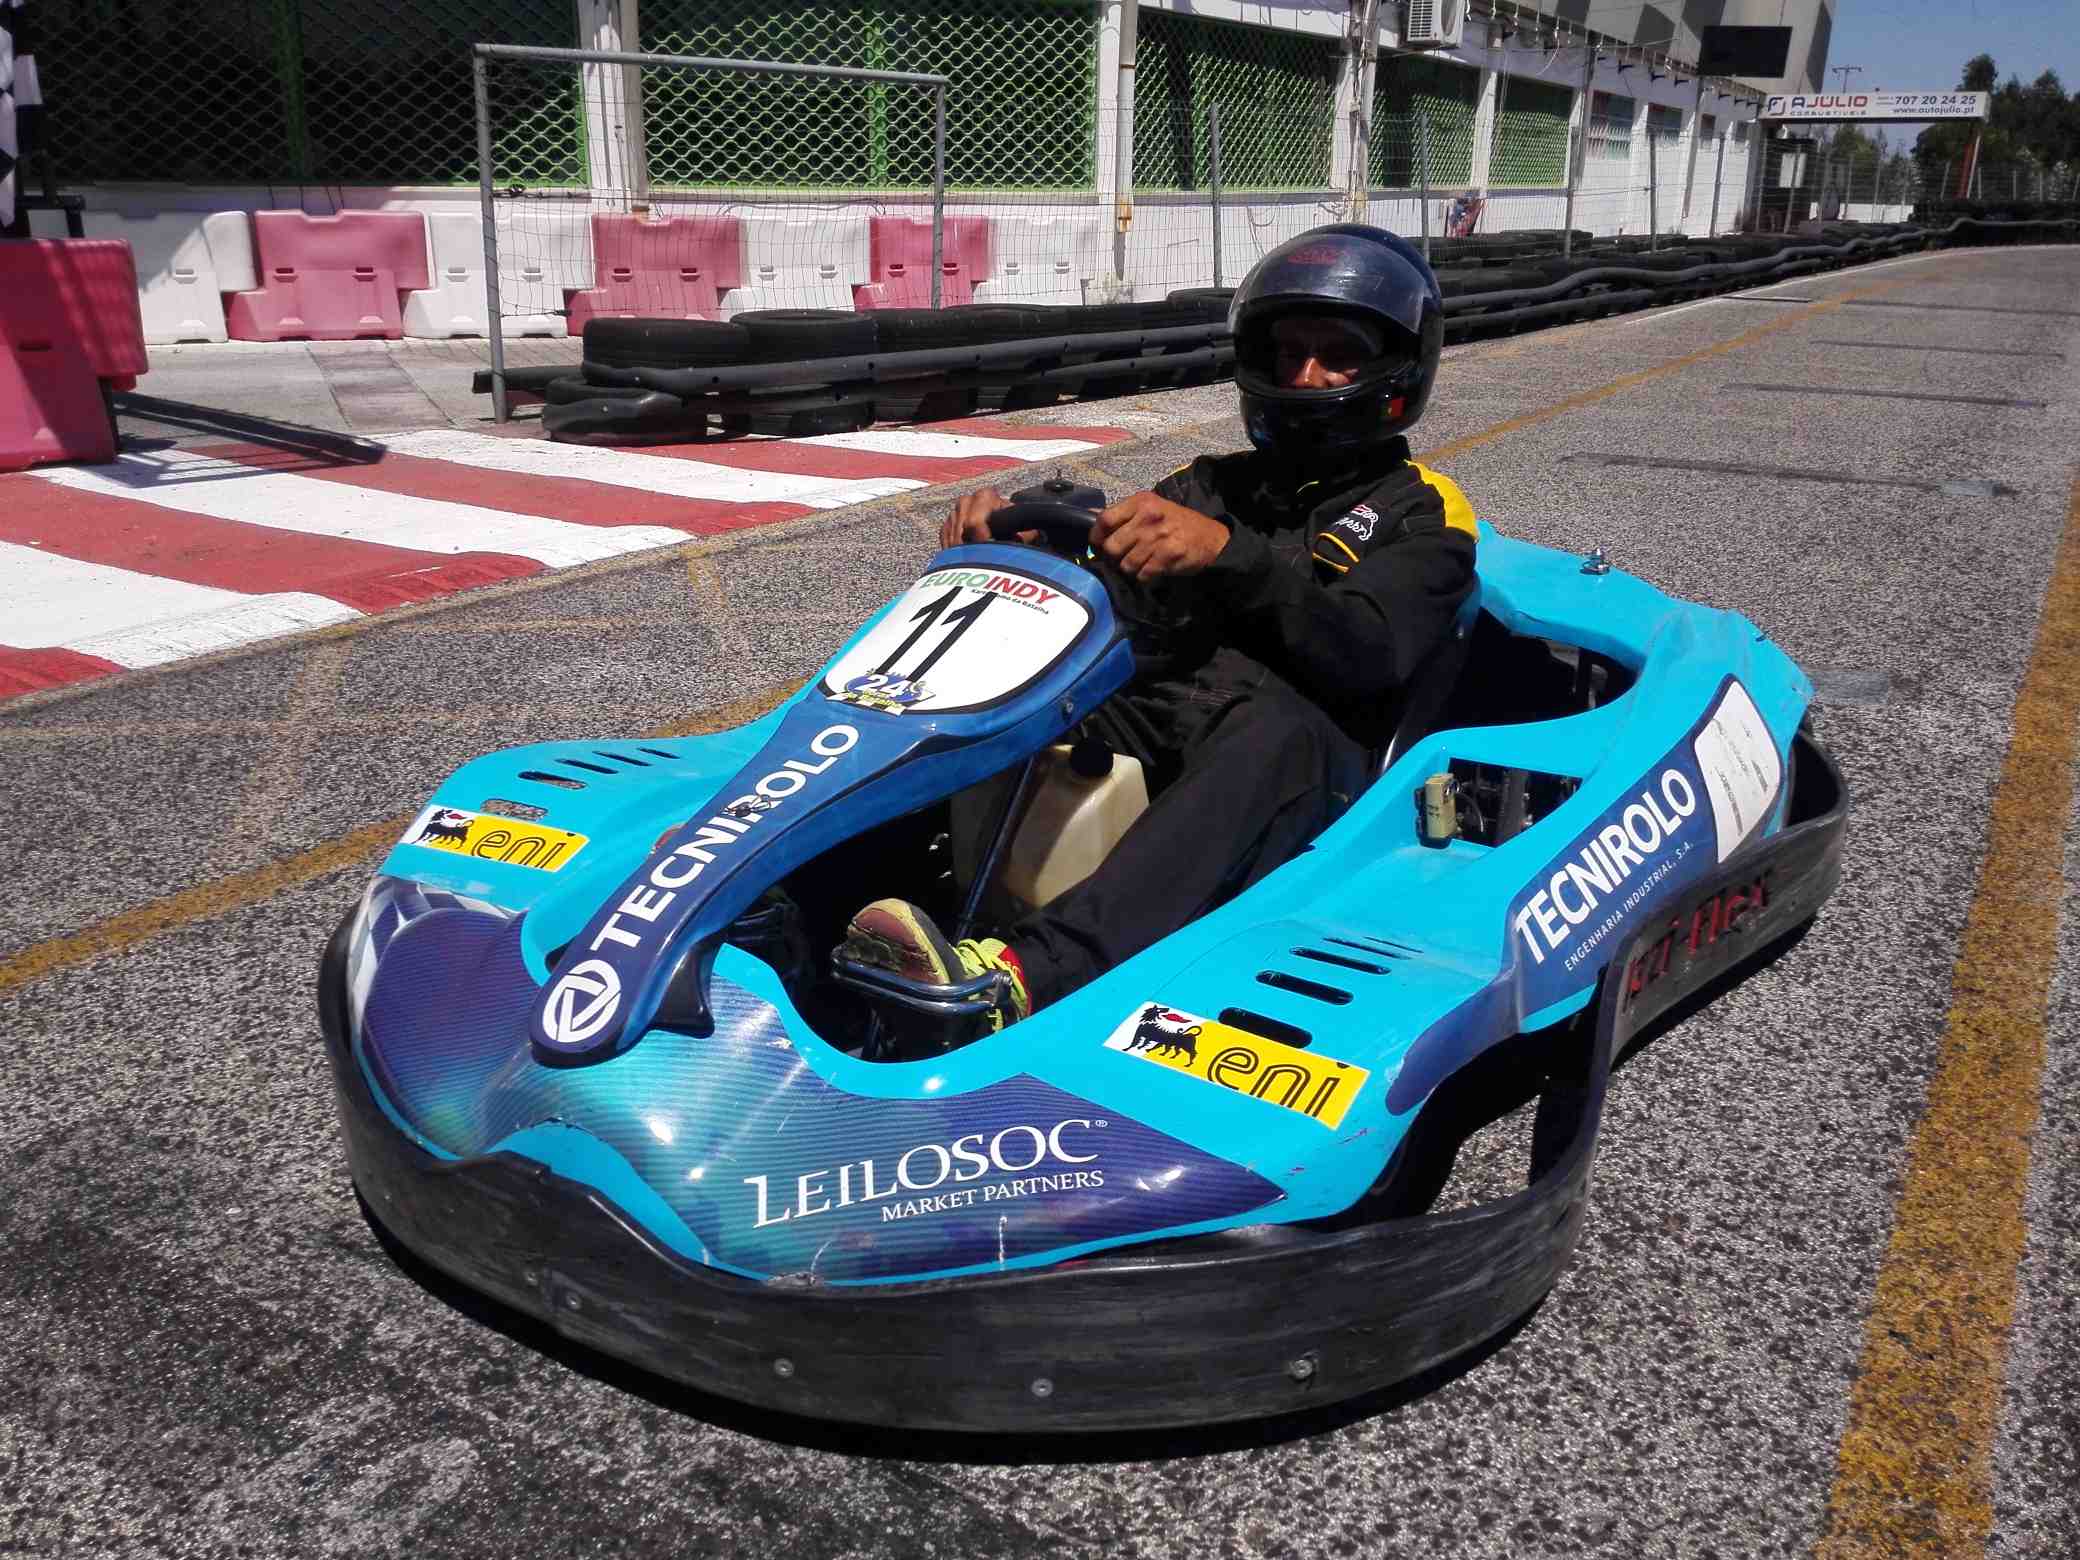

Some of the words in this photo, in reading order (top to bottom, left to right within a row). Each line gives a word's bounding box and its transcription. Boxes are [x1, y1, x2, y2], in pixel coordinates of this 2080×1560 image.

[1894, 95, 1918, 105] 707
[1921, 95, 1937, 105] 20
[1940, 95, 1956, 105] 24
[1960, 95, 1977, 105] 25
[921, 572, 1060, 604] EUROINDY
[874, 585, 999, 683] 11
[471, 829, 577, 869] eni
[589, 724, 860, 950] TECNIROLO
[1515, 768, 1696, 965] TECNIROLO
[1564, 910, 1624, 971] ENGENHARIA
[1207, 1045, 1353, 1119] eni
[881, 1188, 978, 1224] MARKET
[983, 1169, 1105, 1203] PARTNERS
